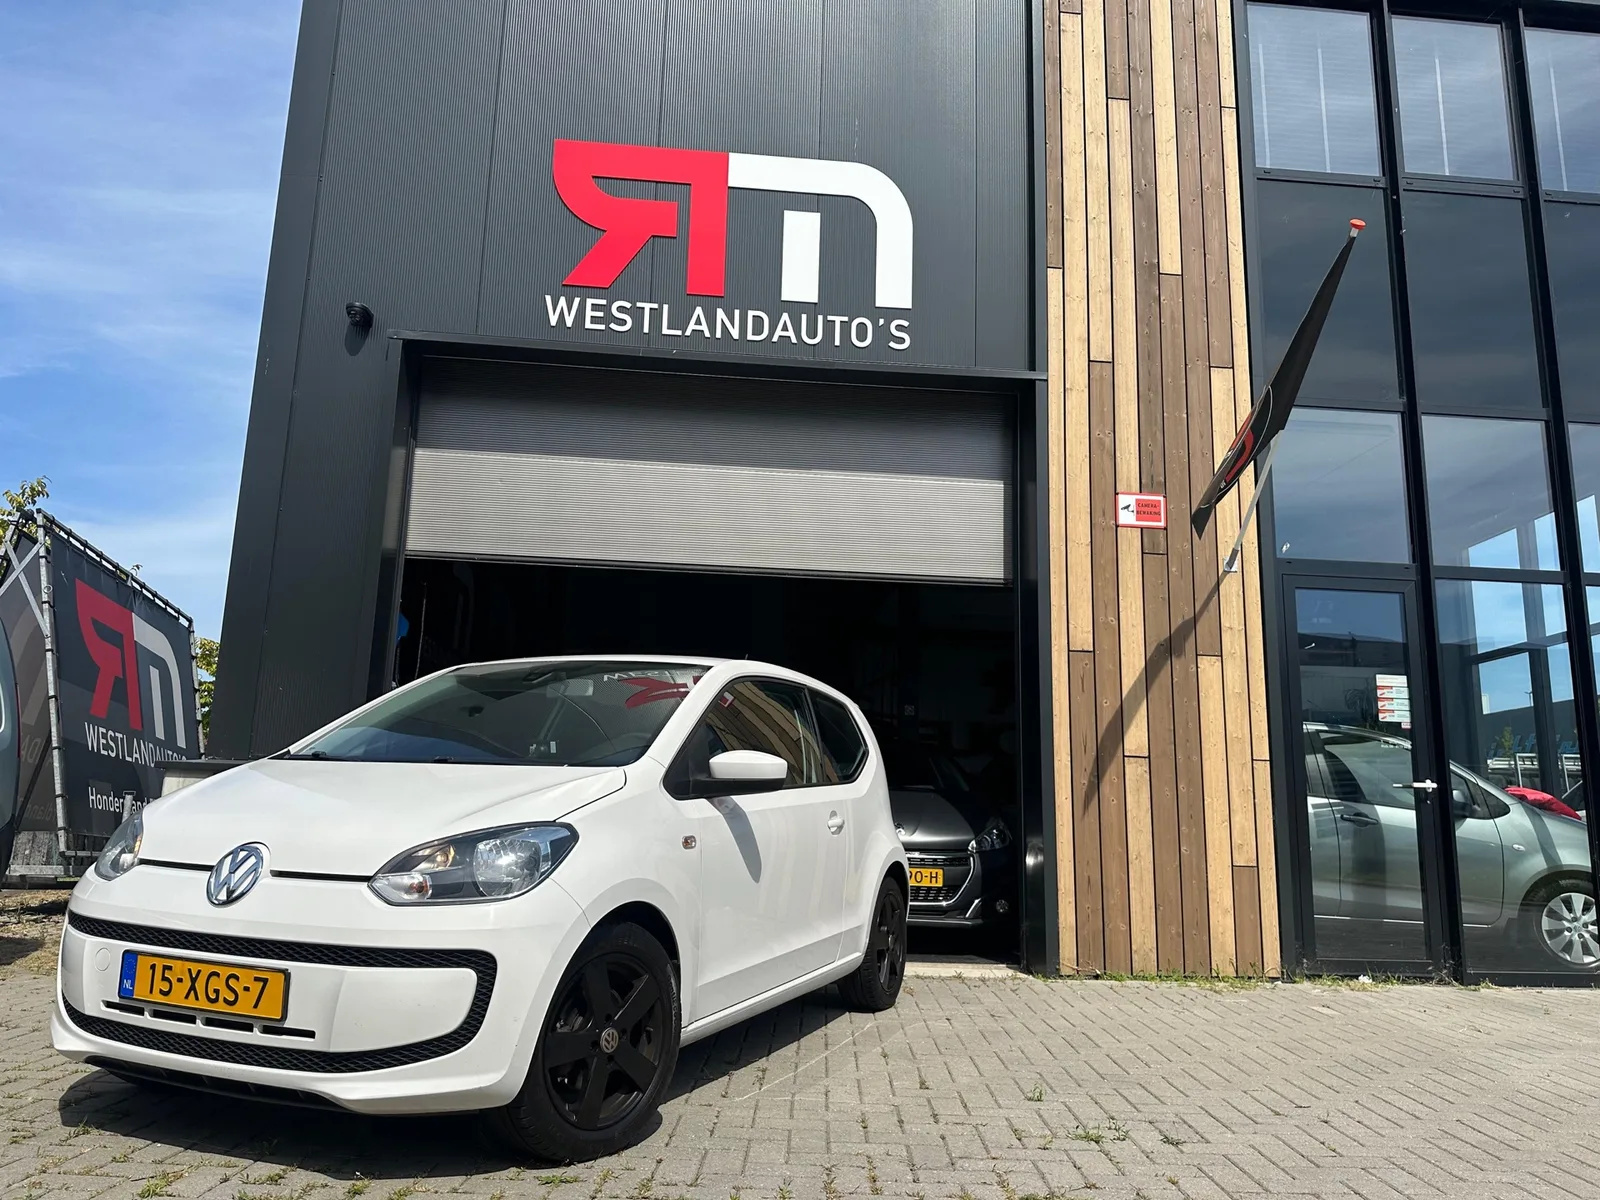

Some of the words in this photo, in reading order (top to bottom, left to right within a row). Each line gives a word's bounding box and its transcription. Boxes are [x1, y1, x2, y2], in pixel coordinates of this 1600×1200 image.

[544, 294, 911, 350] WESTLANDAUTO'S
[84, 721, 186, 768] WESTLANDAUT'
[122, 979, 133, 990] NL
[149, 962, 270, 1009] 15-XGS-7
